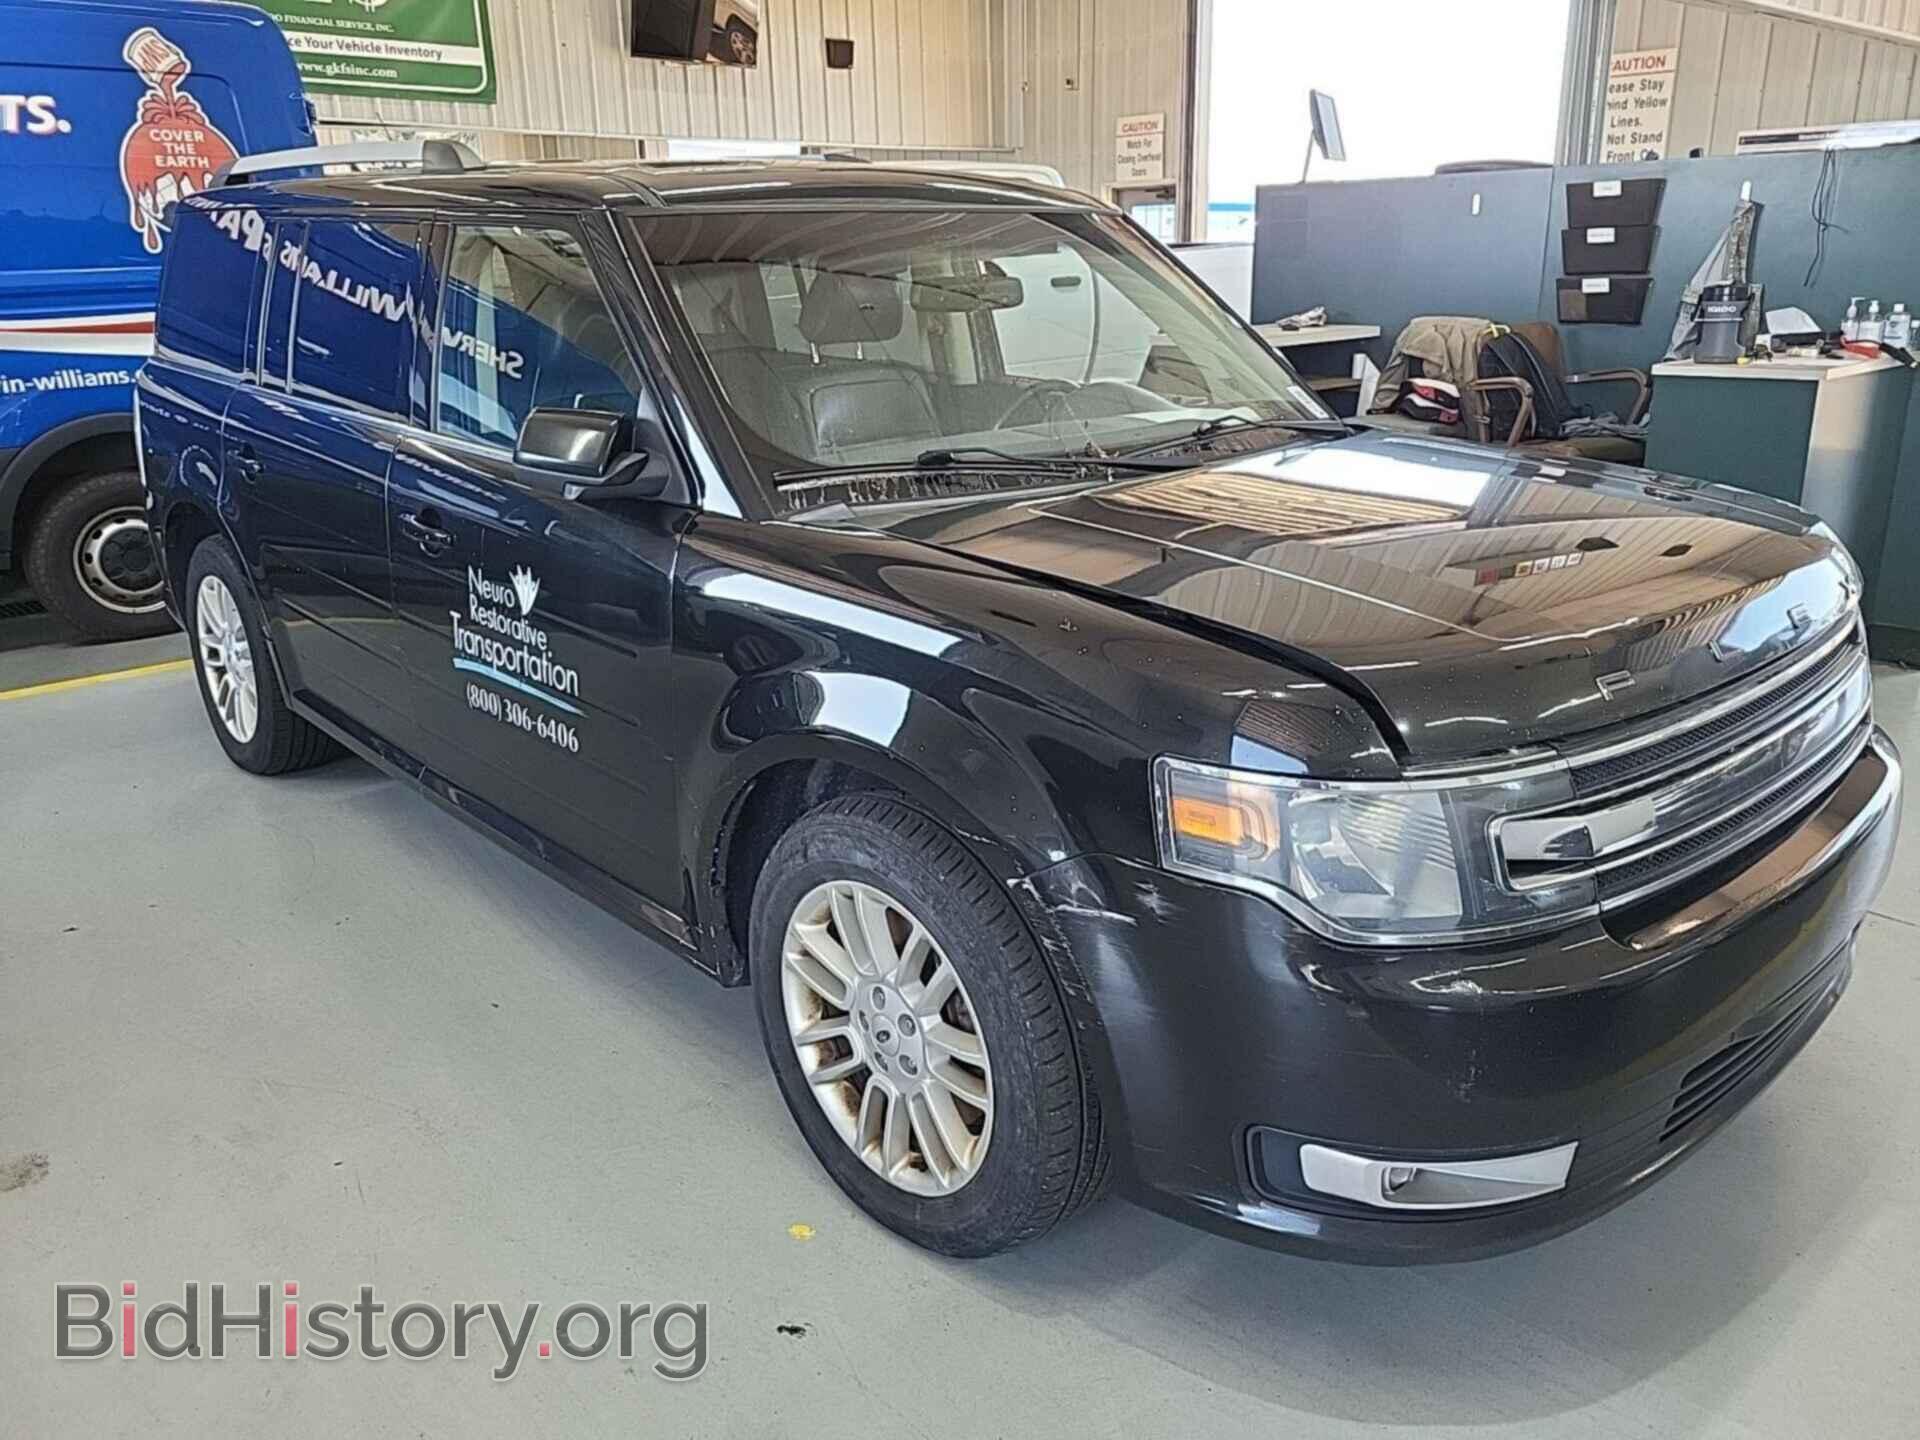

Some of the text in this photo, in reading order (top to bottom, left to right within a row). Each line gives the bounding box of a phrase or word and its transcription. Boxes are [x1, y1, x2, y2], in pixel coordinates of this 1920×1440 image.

[284, 15, 334, 27] FINANCIAL
[376, 24, 394, 33] INC.
[304, 36, 333, 49] Your
[336, 40, 382, 54] Vehicle
[385, 44, 442, 61] Inventory
[1640, 78, 1664, 93] Stay
[1634, 96, 1668, 109] Yellow
[1121, 120, 1158, 133] CAUTION
[1611, 115, 1643, 128] Lines.
[149, 129, 204, 142] COVER
[1607, 130, 1663, 145] Not Stand
[163, 142, 196, 154] THE
[155, 156, 209, 168] EARTH
[0, 369, 136, 394] in-williams.
[468, 564, 515, 608] Neuro
[469, 593, 547, 650] Restorative
[450, 610, 579, 697] Transportation
[467, 682, 579, 753] (800) 306-6406
